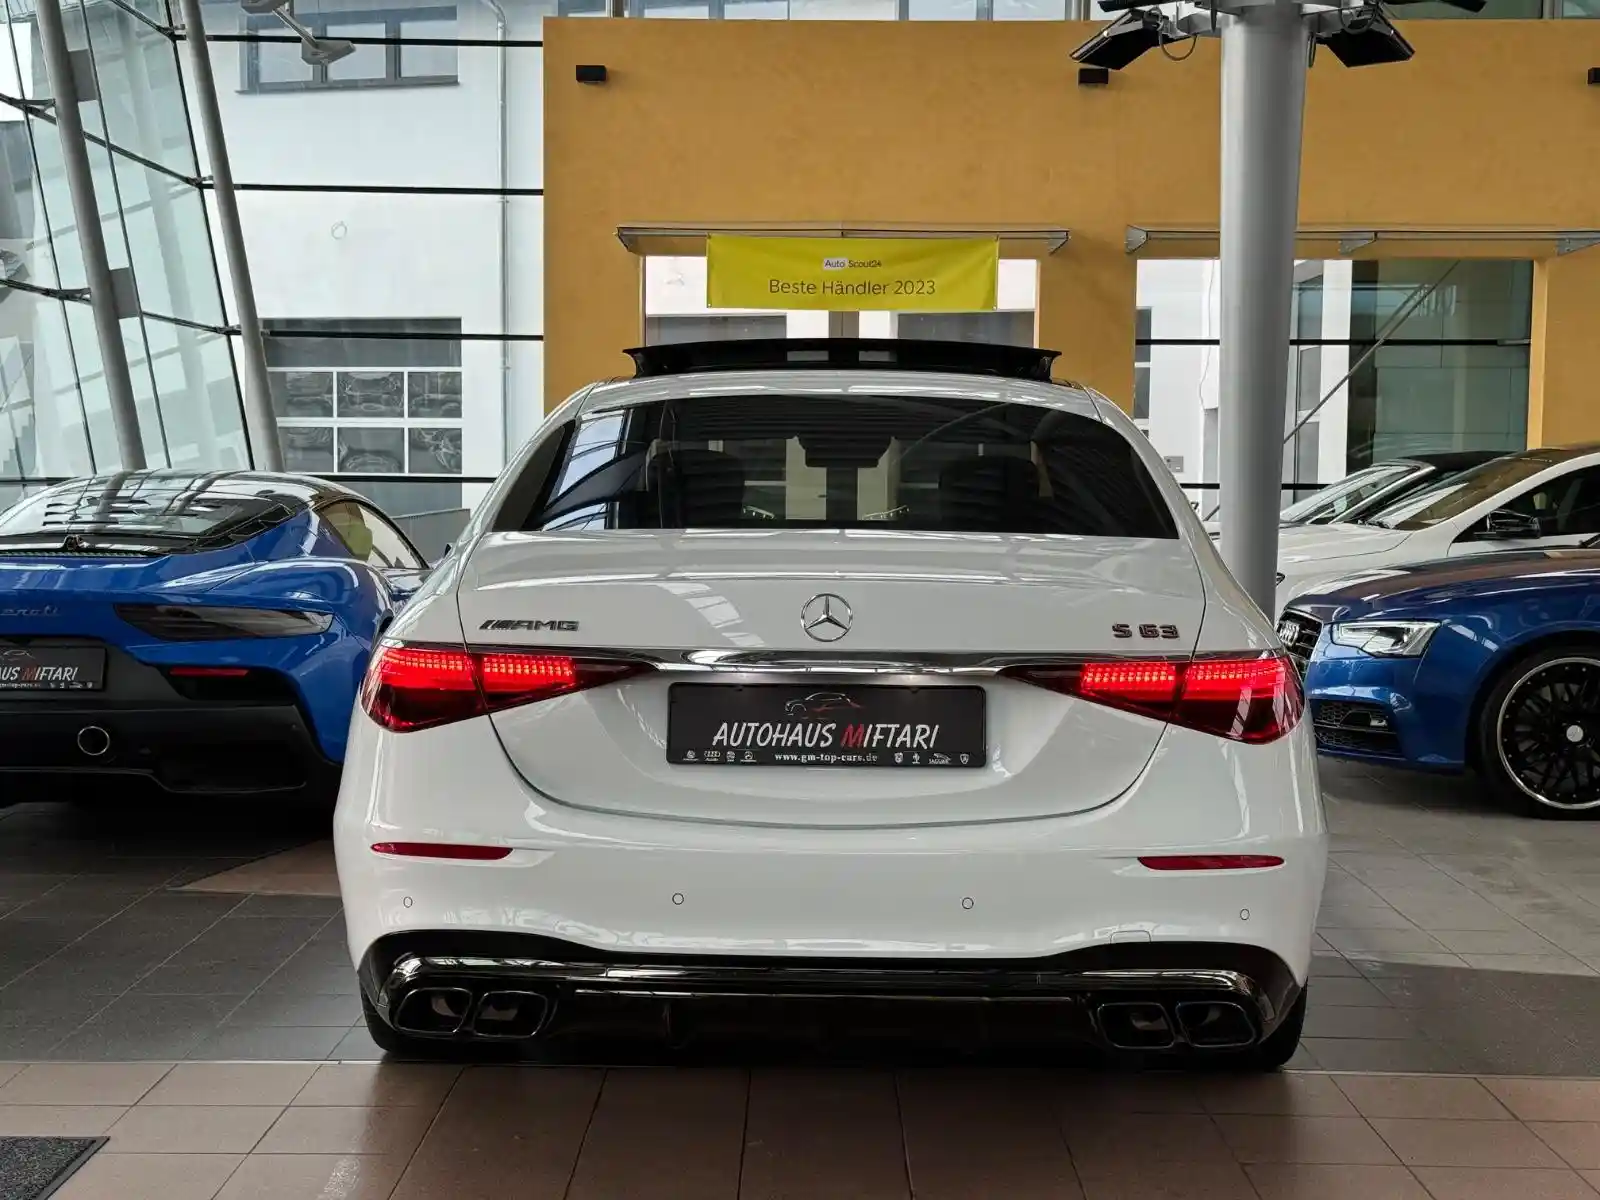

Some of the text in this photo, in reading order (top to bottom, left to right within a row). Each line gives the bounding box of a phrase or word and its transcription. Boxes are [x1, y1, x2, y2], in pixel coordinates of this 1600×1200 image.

[824, 259, 883, 269] Auto Scout24
[769, 279, 936, 295] Beste Händler 2023
[1111, 623, 1180, 639] S 63
[0, 667, 78, 681] US MIFTARI
[712, 722, 940, 749] AUTOHAUS MIFTARI
[774, 753, 879, 764] www.gm-top-cars.de
